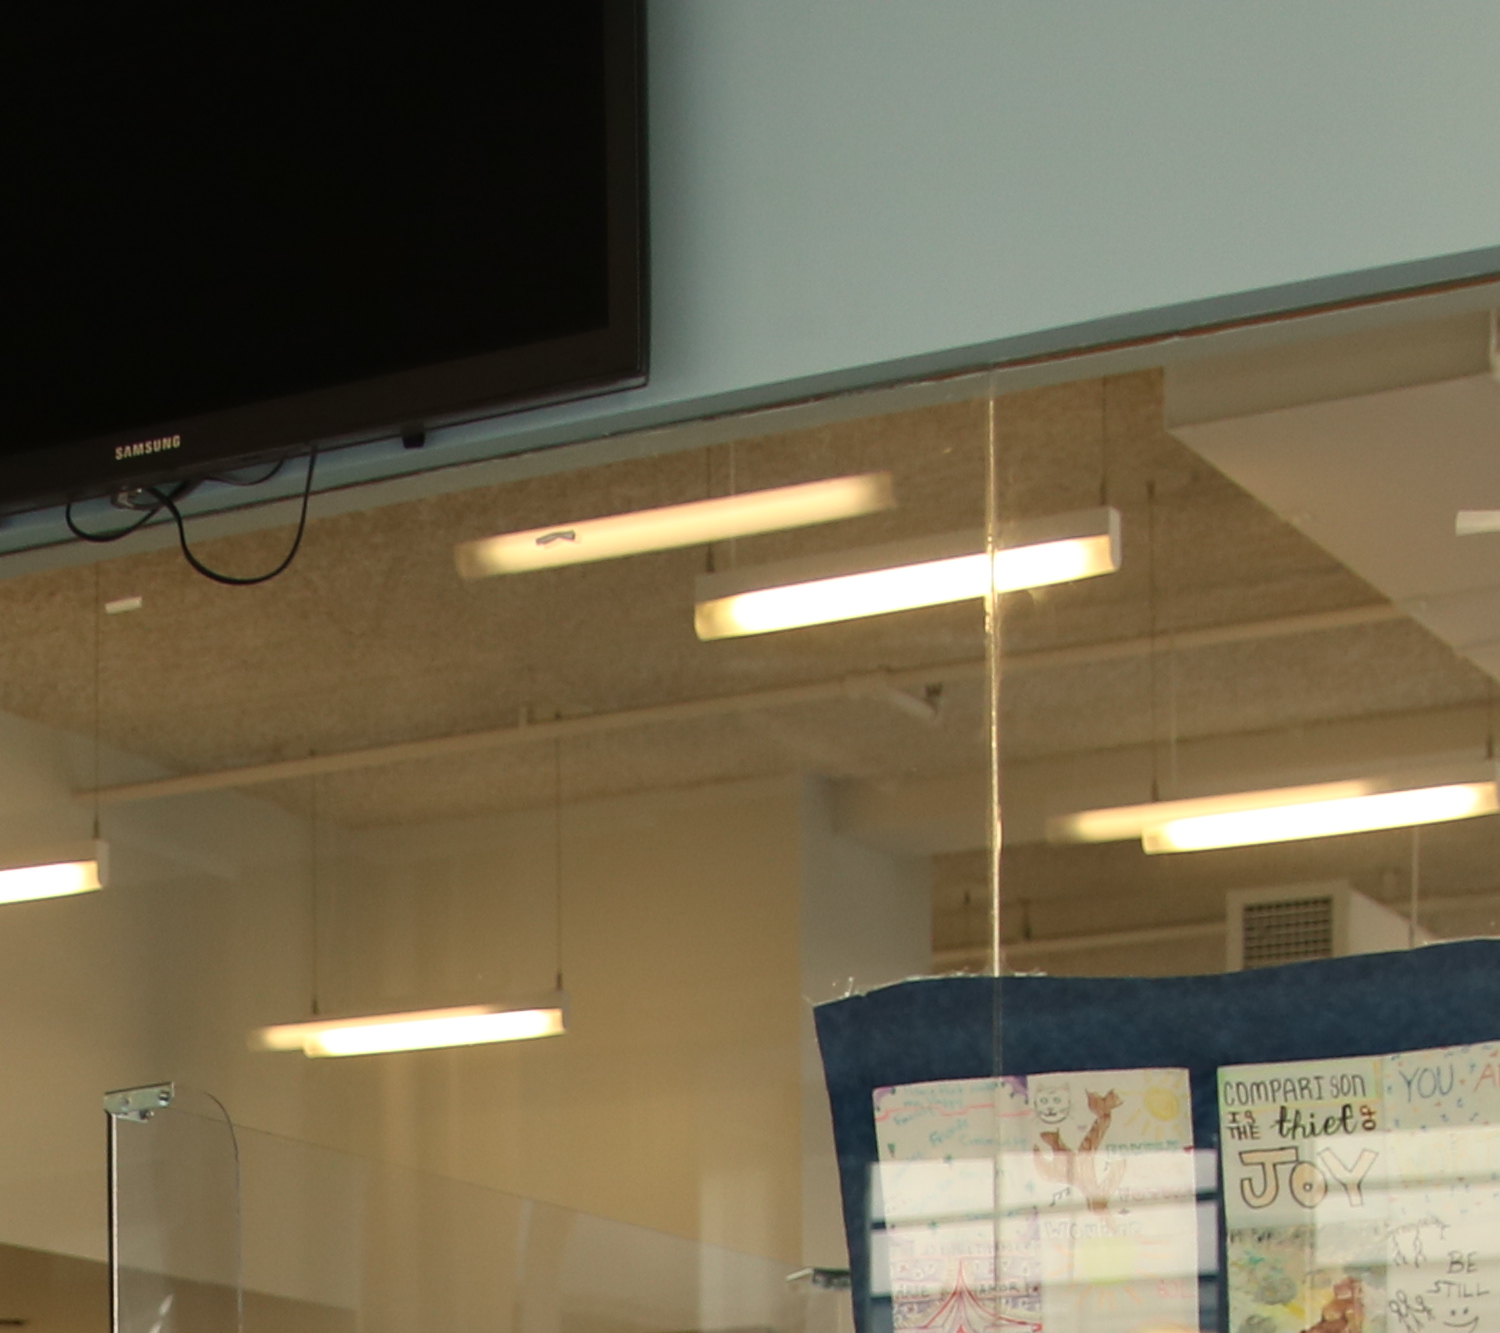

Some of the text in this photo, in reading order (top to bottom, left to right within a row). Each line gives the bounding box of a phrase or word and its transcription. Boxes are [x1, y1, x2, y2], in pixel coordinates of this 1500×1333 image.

[114, 434, 180, 460] SAMSUNG
[1399, 1064, 1454, 1103] YOU
[1239, 1146, 1379, 1209] JOY
[1447, 1251, 1478, 1274] BE
[1426, 1279, 1490, 1298] STILL
